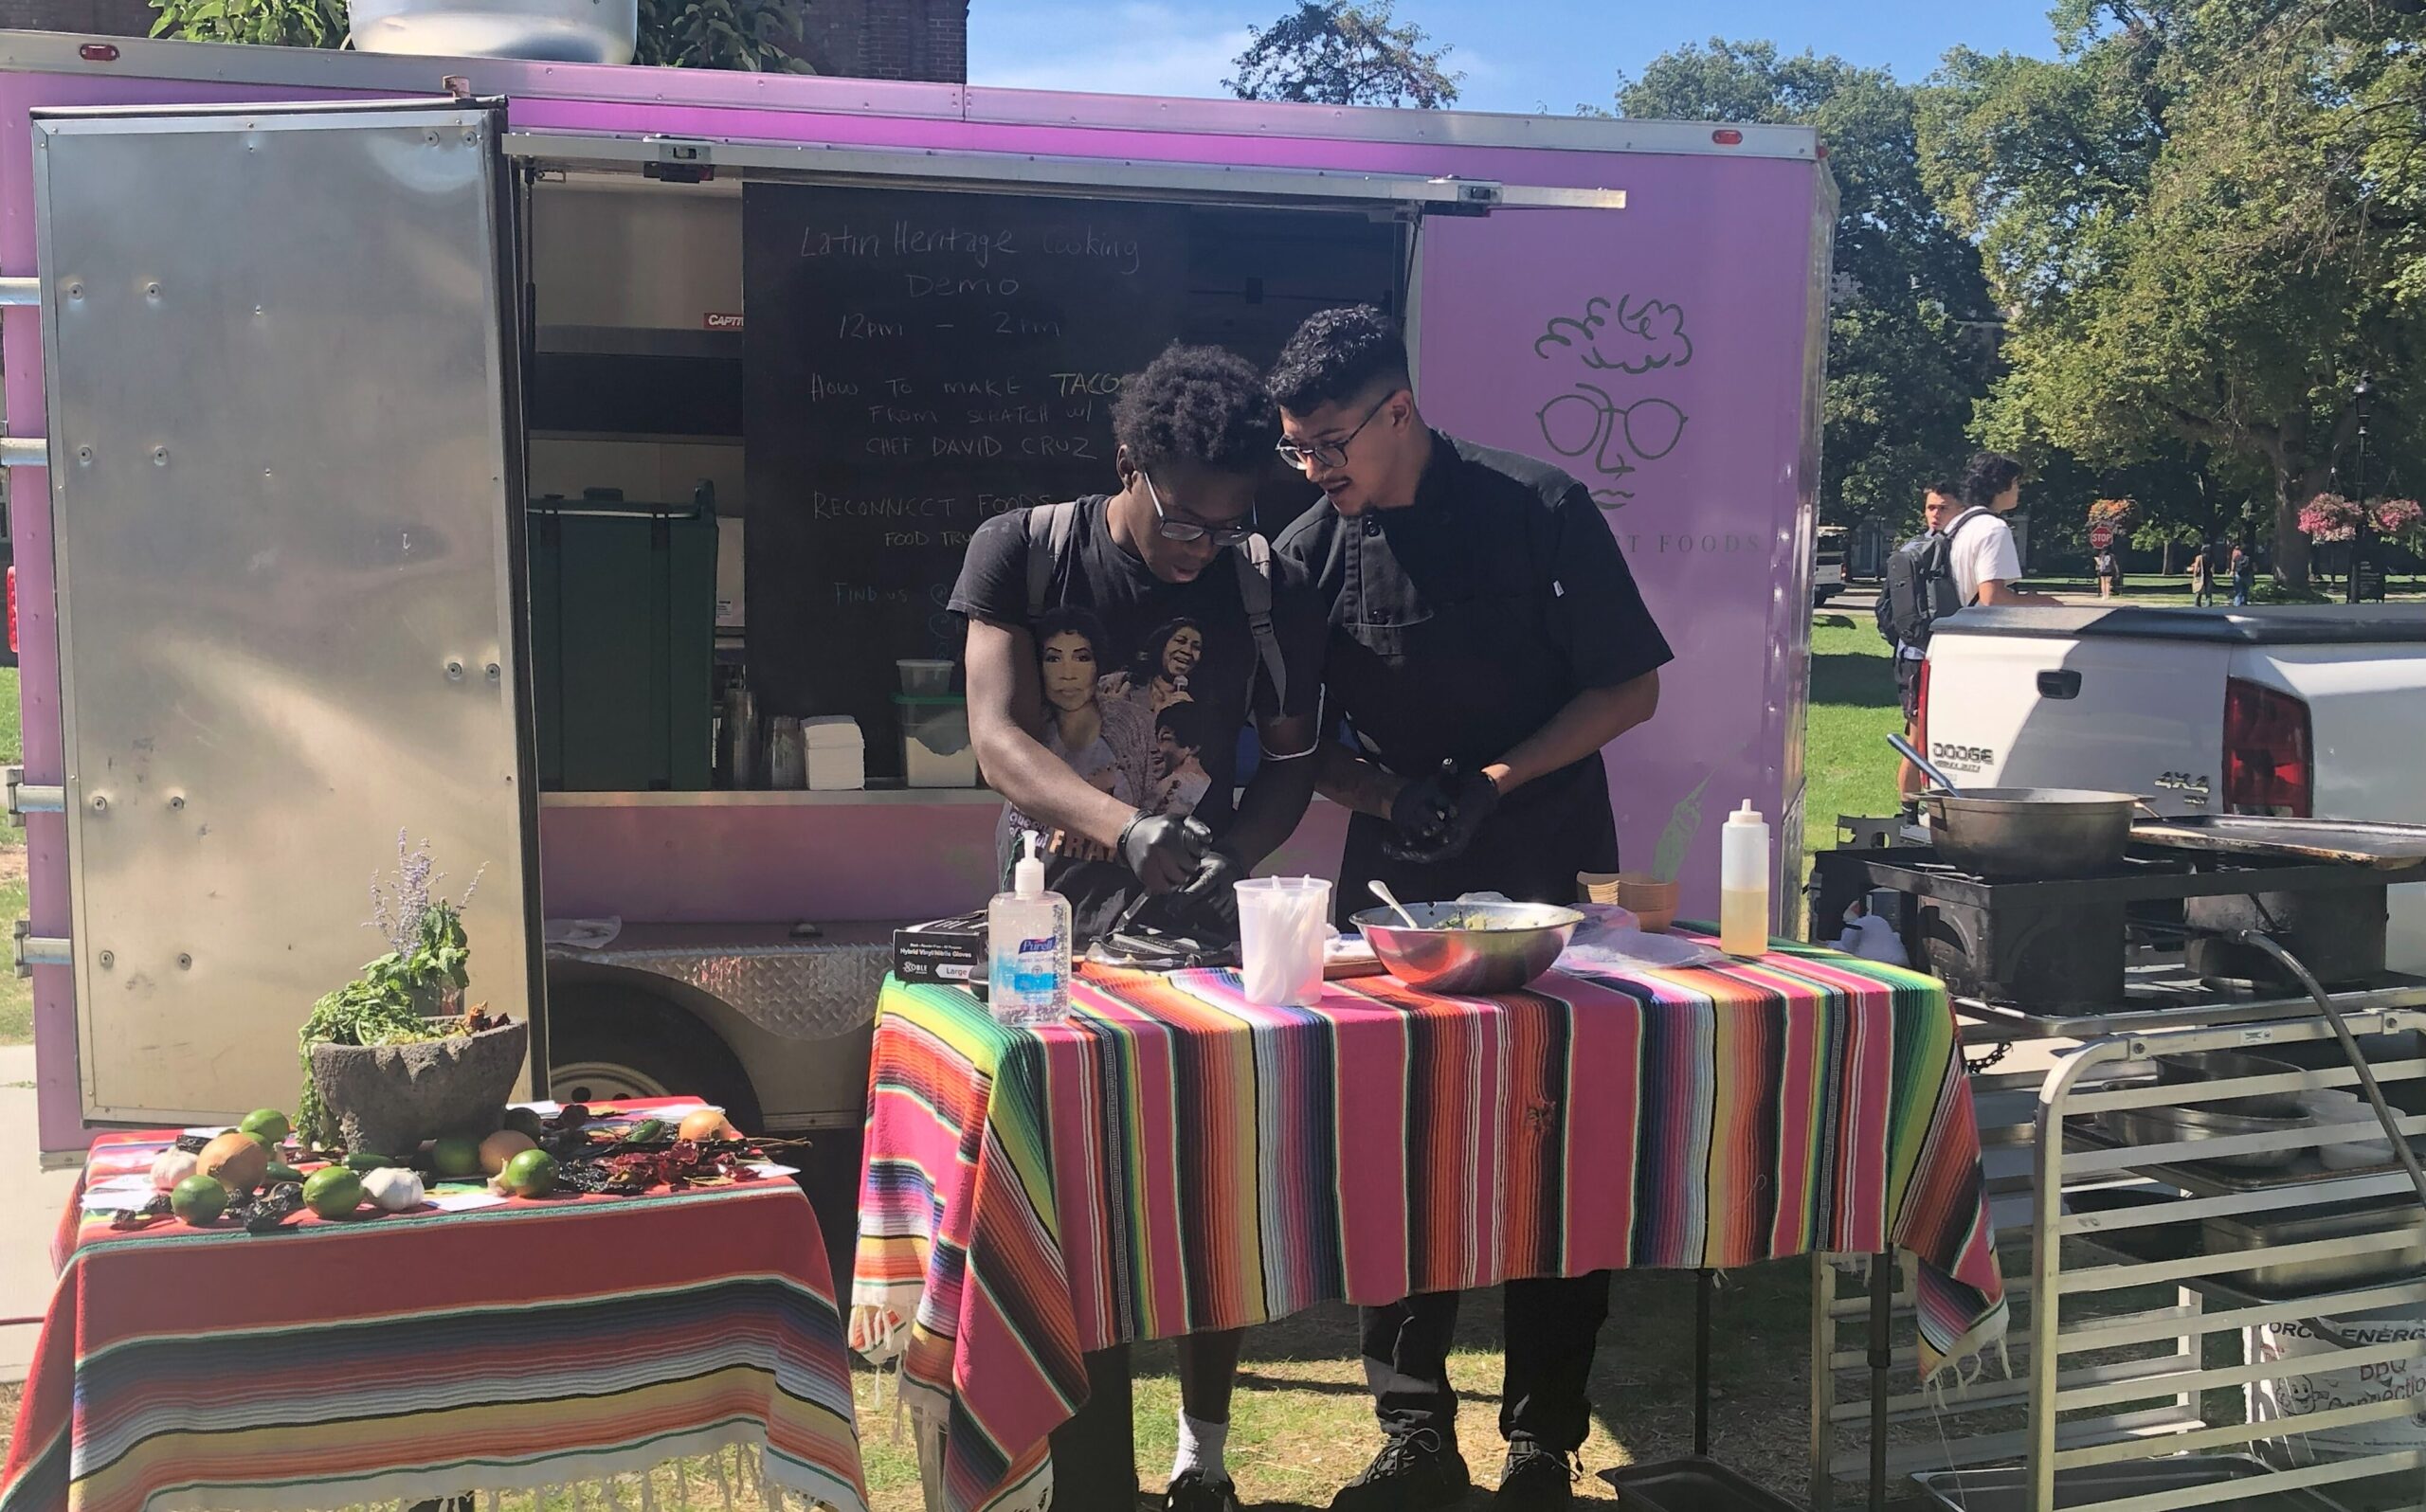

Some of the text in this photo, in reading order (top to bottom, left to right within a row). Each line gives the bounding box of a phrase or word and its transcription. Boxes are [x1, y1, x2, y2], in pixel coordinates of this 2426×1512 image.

[801, 221, 1140, 275] Latin Heritage Cooking
[708, 314, 744, 327] CAPTI
[865, 436, 1098, 459] CHEF DAVID CRUZ
[884, 531, 972, 547] FOOD TRU
[1659, 534, 1762, 553] FOODS
[2091, 533, 2111, 542] STOP
[1933, 743, 1994, 765] DODGE
[899, 947, 918, 956] Hybrid
[951, 950, 972, 959] Gloves
[1023, 939, 1054, 951] Purell
[946, 967, 968, 977] Large
[2341, 1327, 2426, 1343] ENERG
